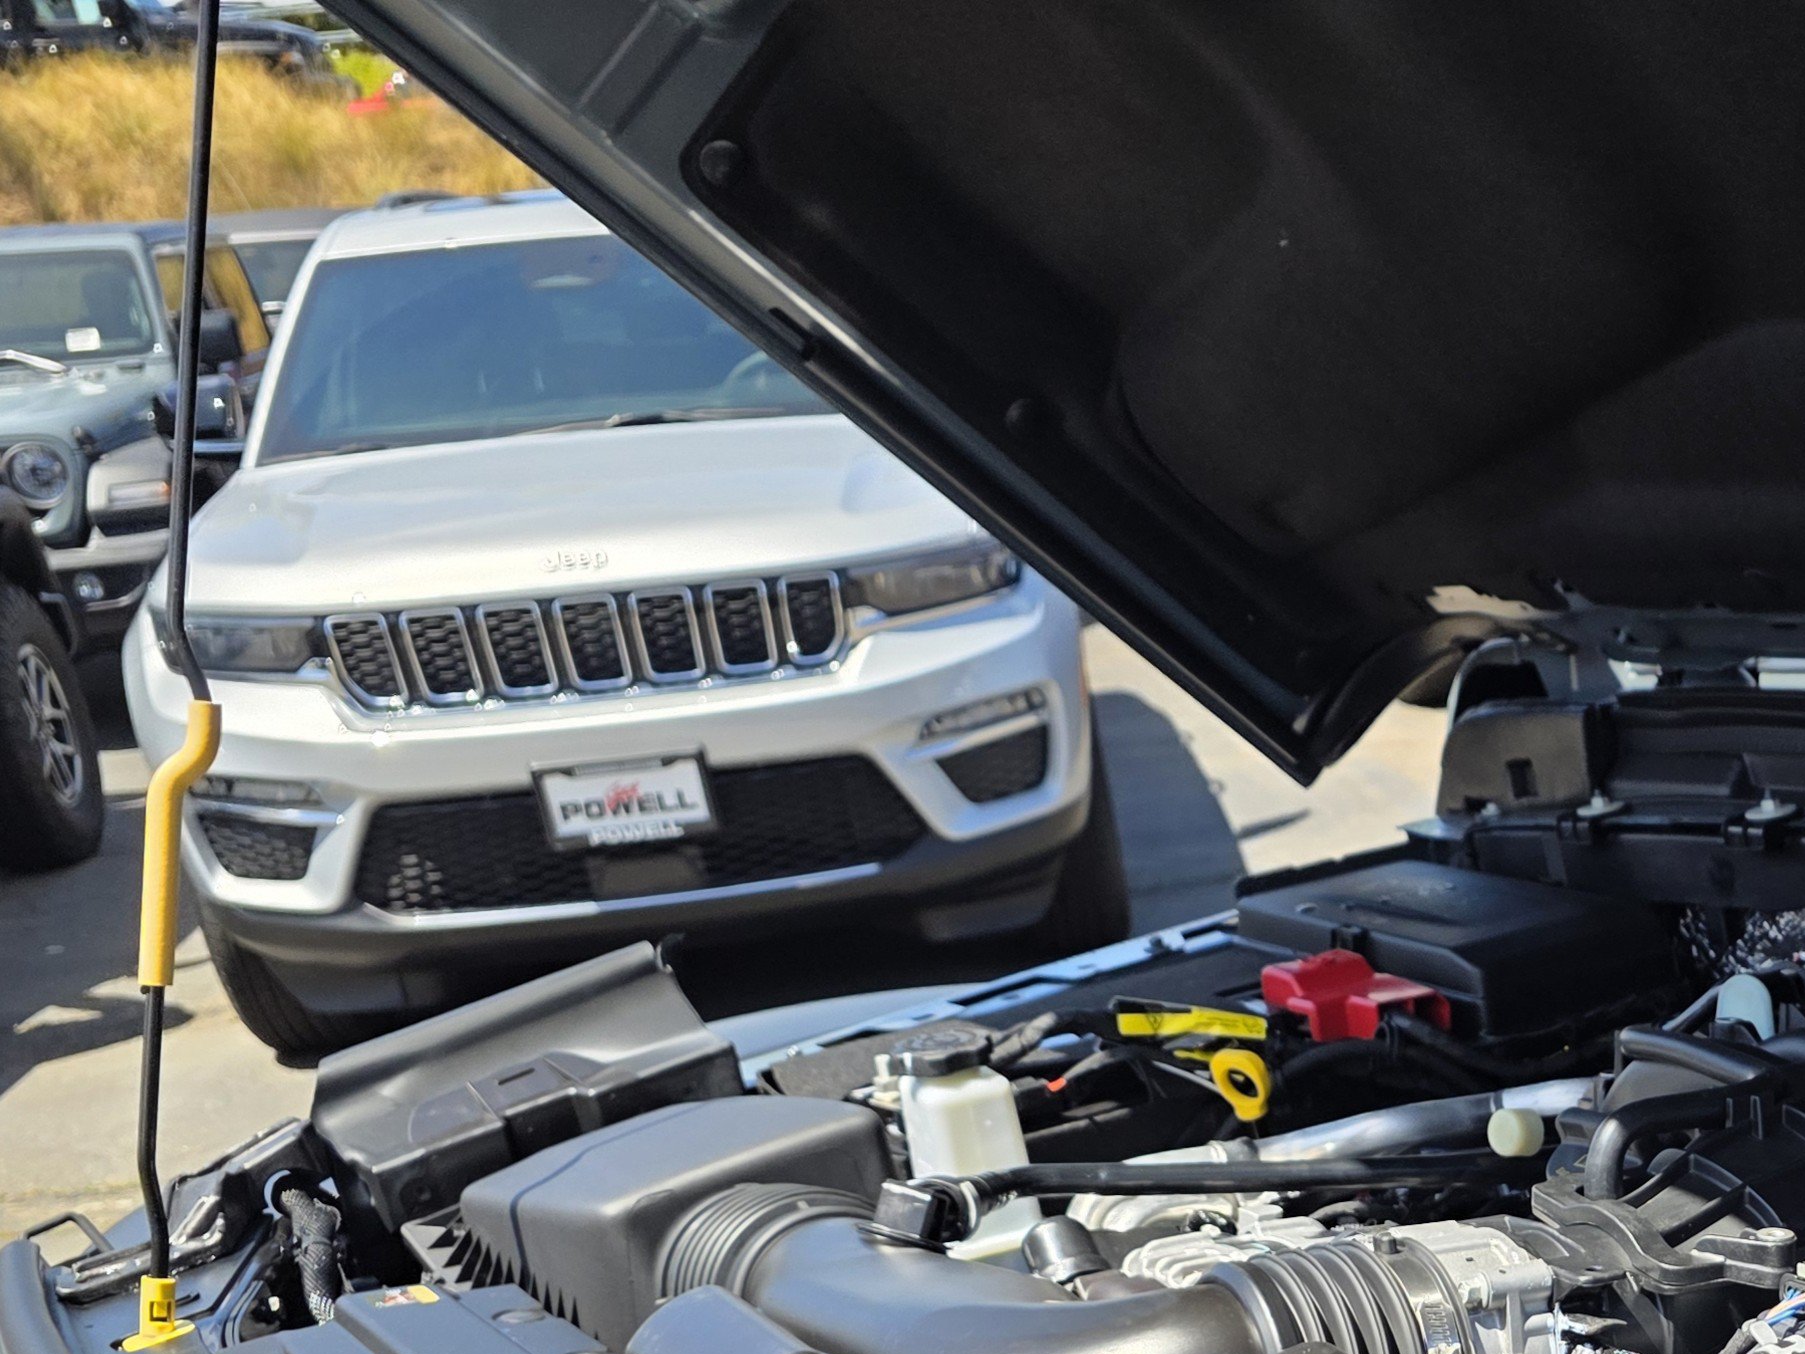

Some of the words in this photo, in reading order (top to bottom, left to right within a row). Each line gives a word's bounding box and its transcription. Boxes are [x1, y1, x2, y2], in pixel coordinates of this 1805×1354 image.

[541, 550, 609, 573] Jeep
[559, 787, 700, 822] POWELL
[590, 821, 684, 845] POWELL
